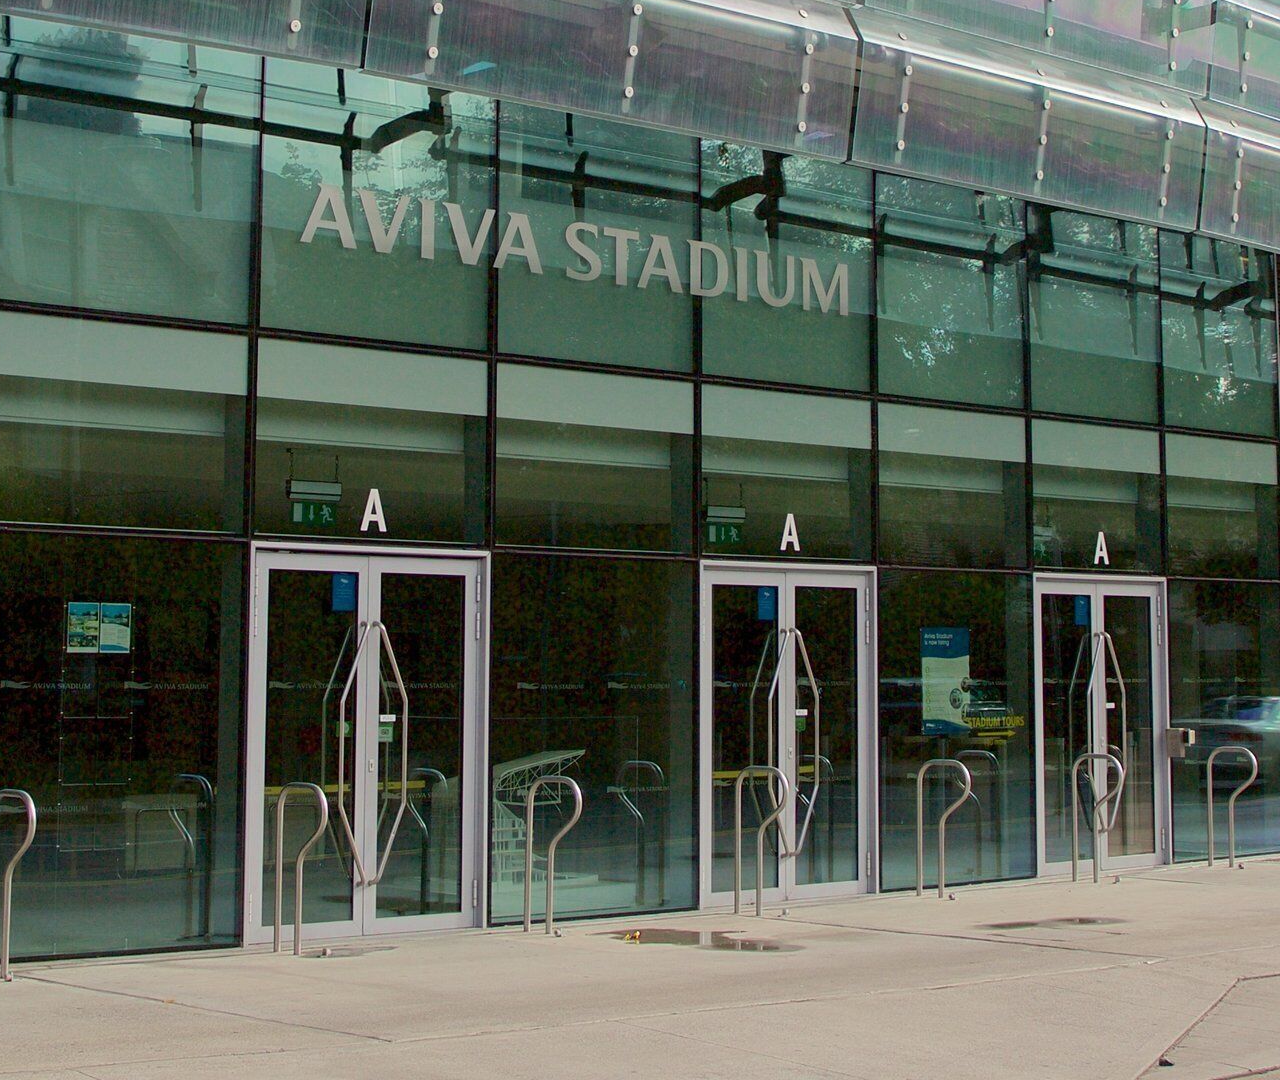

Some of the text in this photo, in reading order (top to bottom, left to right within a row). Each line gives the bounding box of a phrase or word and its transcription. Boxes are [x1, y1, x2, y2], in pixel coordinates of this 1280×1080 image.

[299, 182, 849, 317] AVIVA STADIUM
[360, 488, 387, 532] A
[780, 513, 801, 552] A
[1093, 531, 1110, 565] A
